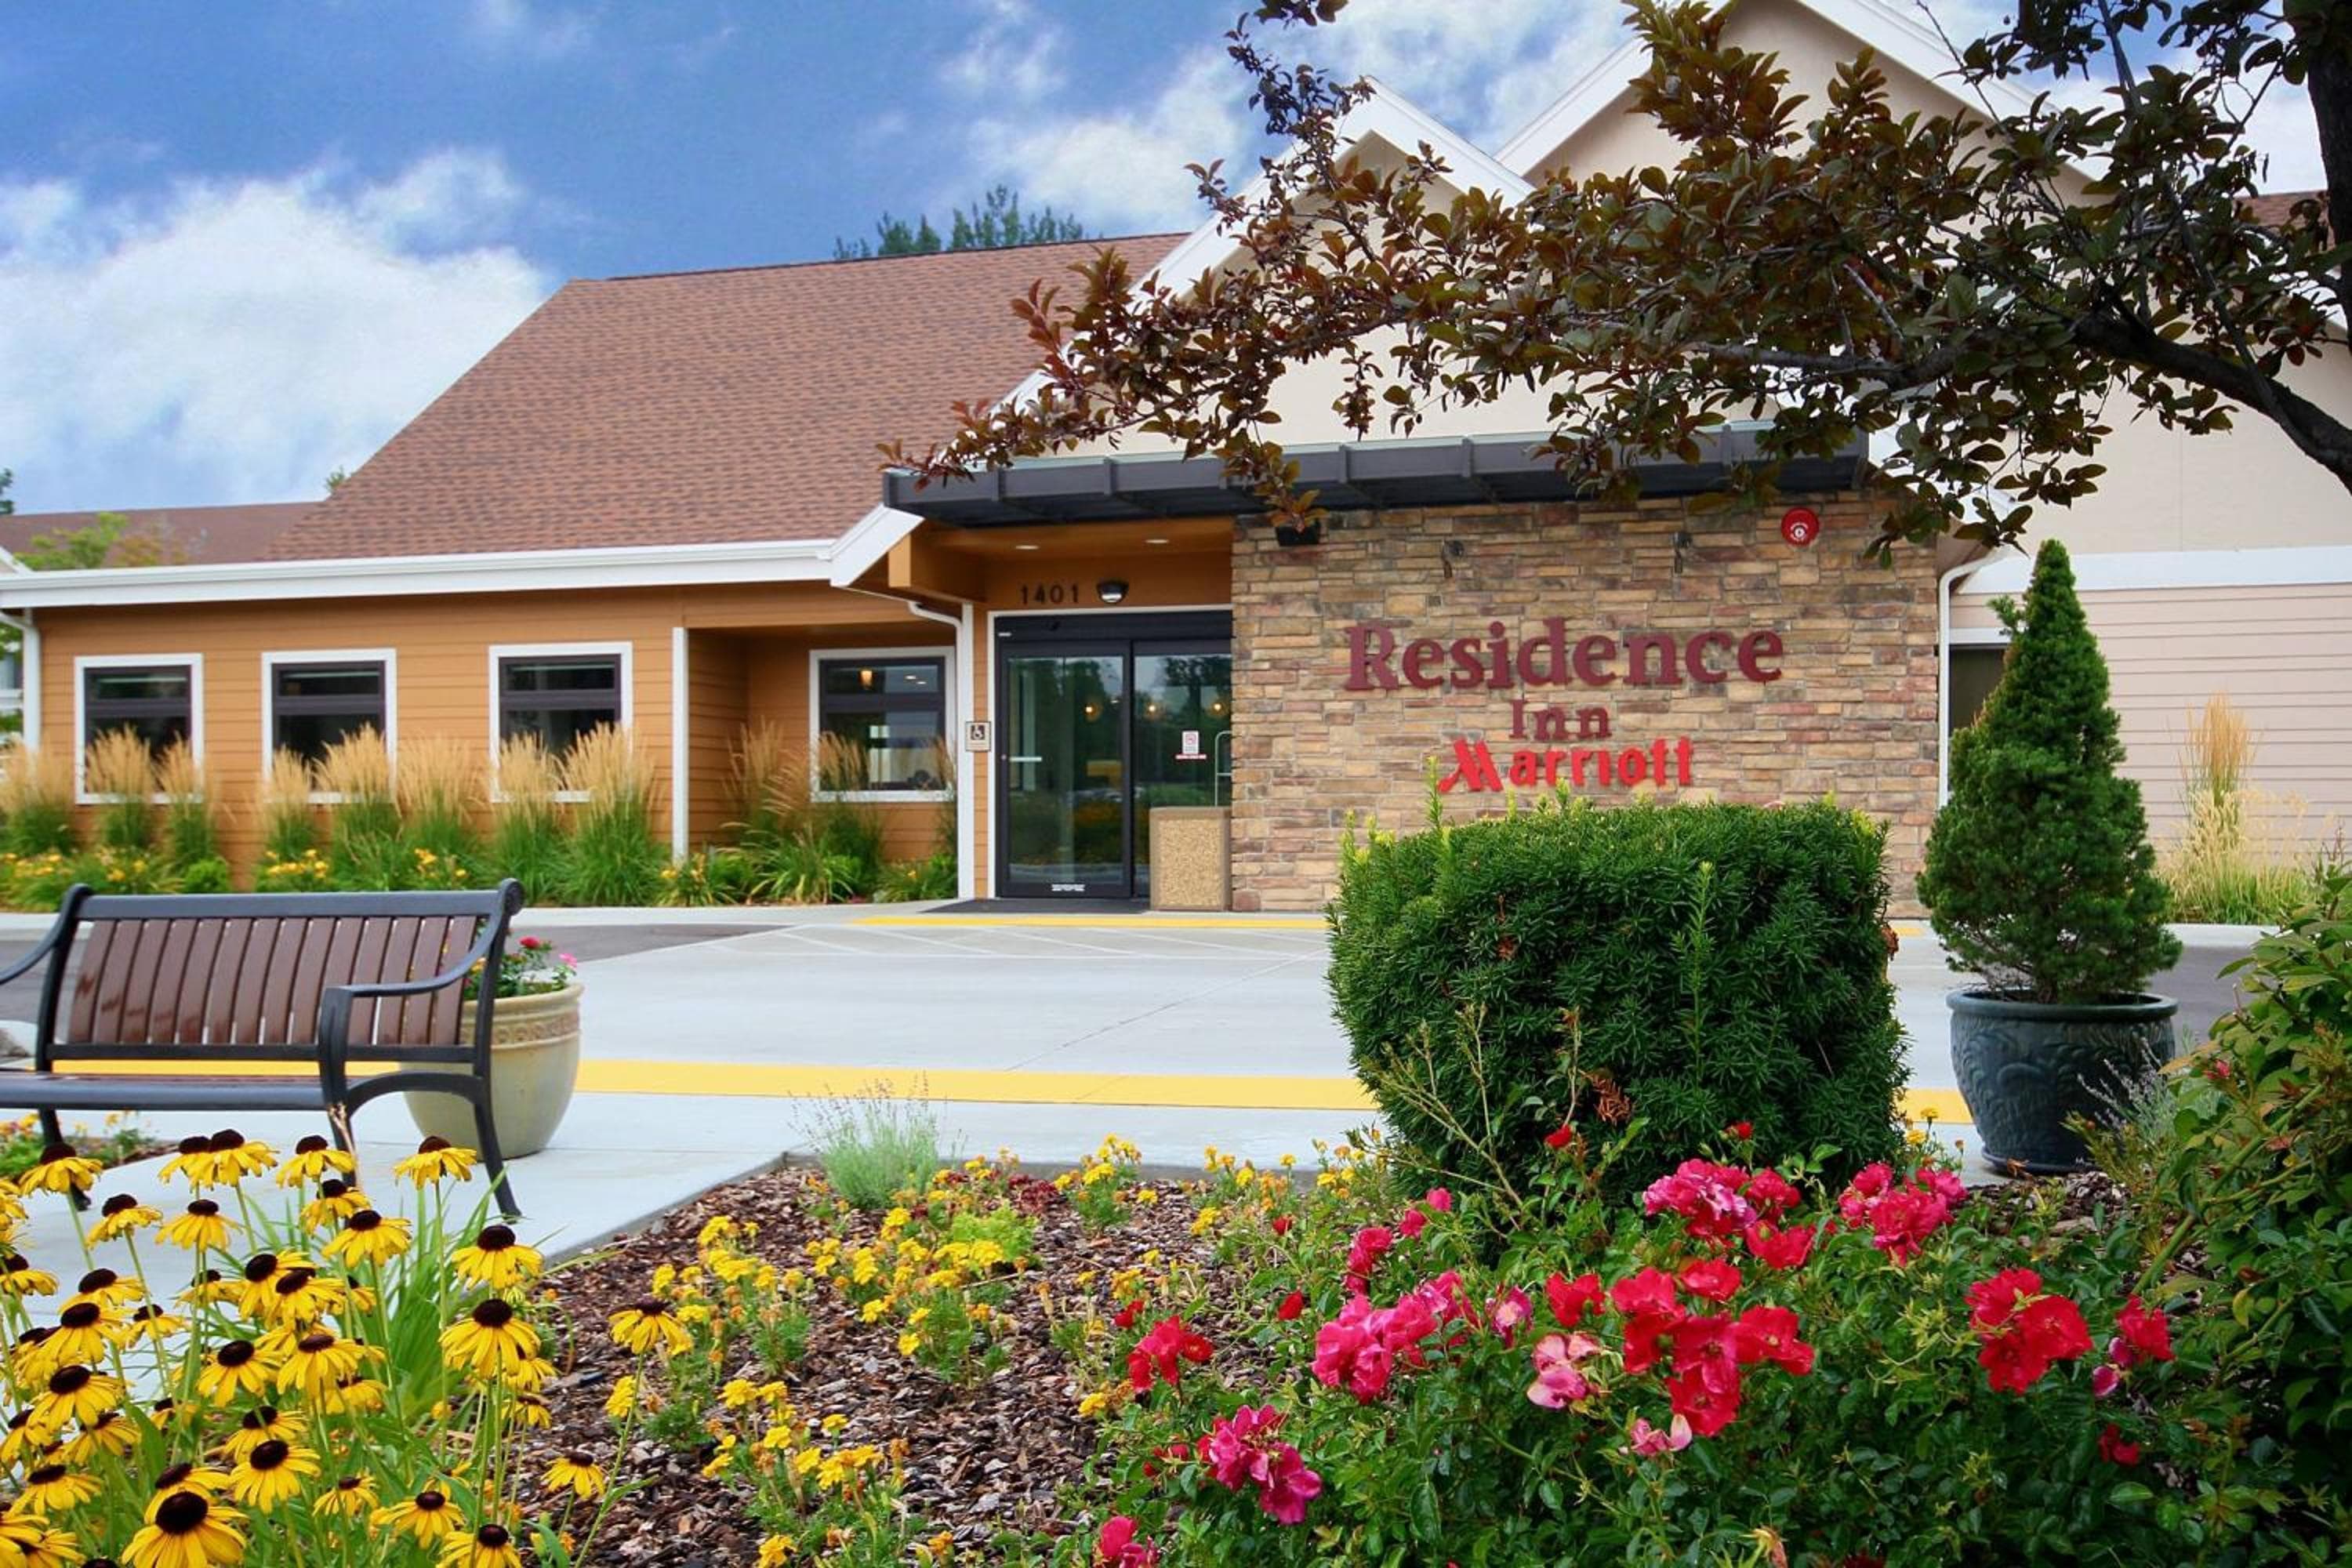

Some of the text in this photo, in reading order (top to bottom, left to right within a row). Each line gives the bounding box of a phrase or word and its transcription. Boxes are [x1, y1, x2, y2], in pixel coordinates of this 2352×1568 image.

[1020, 583, 1079, 604] 1401
[1345, 616, 1783, 691] Residence
[1508, 699, 1612, 740] Inn
[1437, 735, 1693, 792] Marriott
